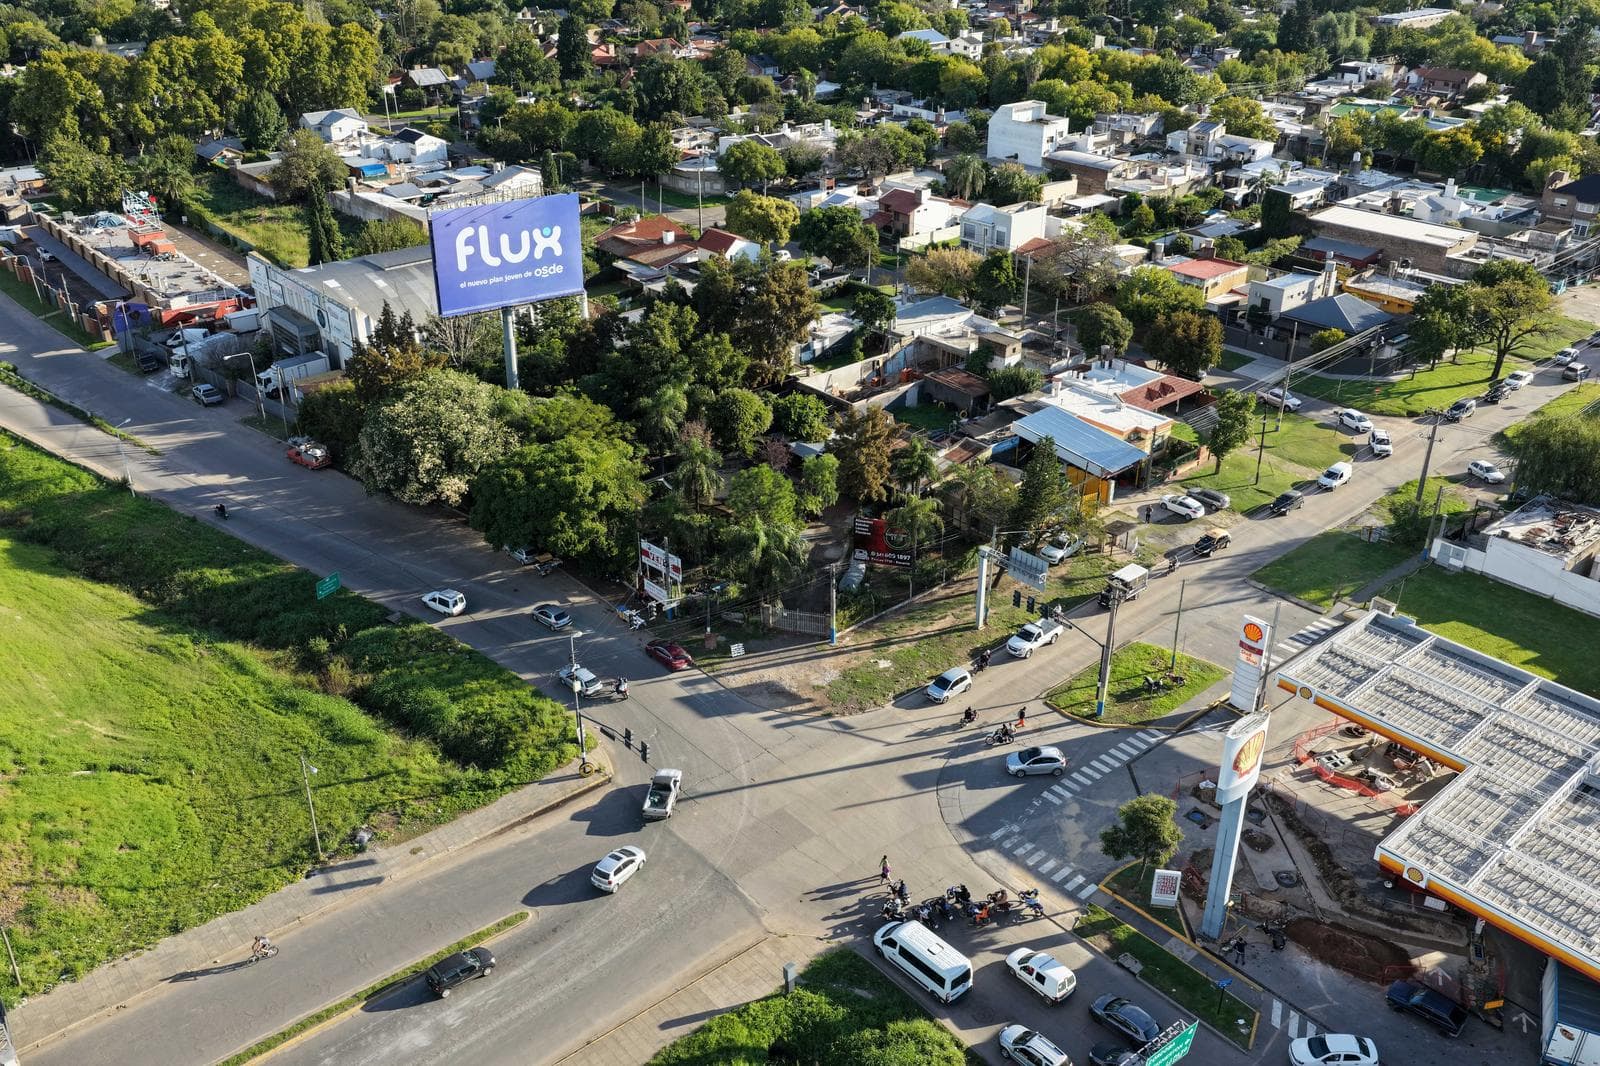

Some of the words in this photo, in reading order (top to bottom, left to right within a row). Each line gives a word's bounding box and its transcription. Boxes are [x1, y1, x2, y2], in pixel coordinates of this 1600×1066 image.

[467, 279, 488, 287] nuevo
[489, 276, 503, 285] plan
[504, 273, 523, 282] joven
[534, 264, 563, 277] osde
